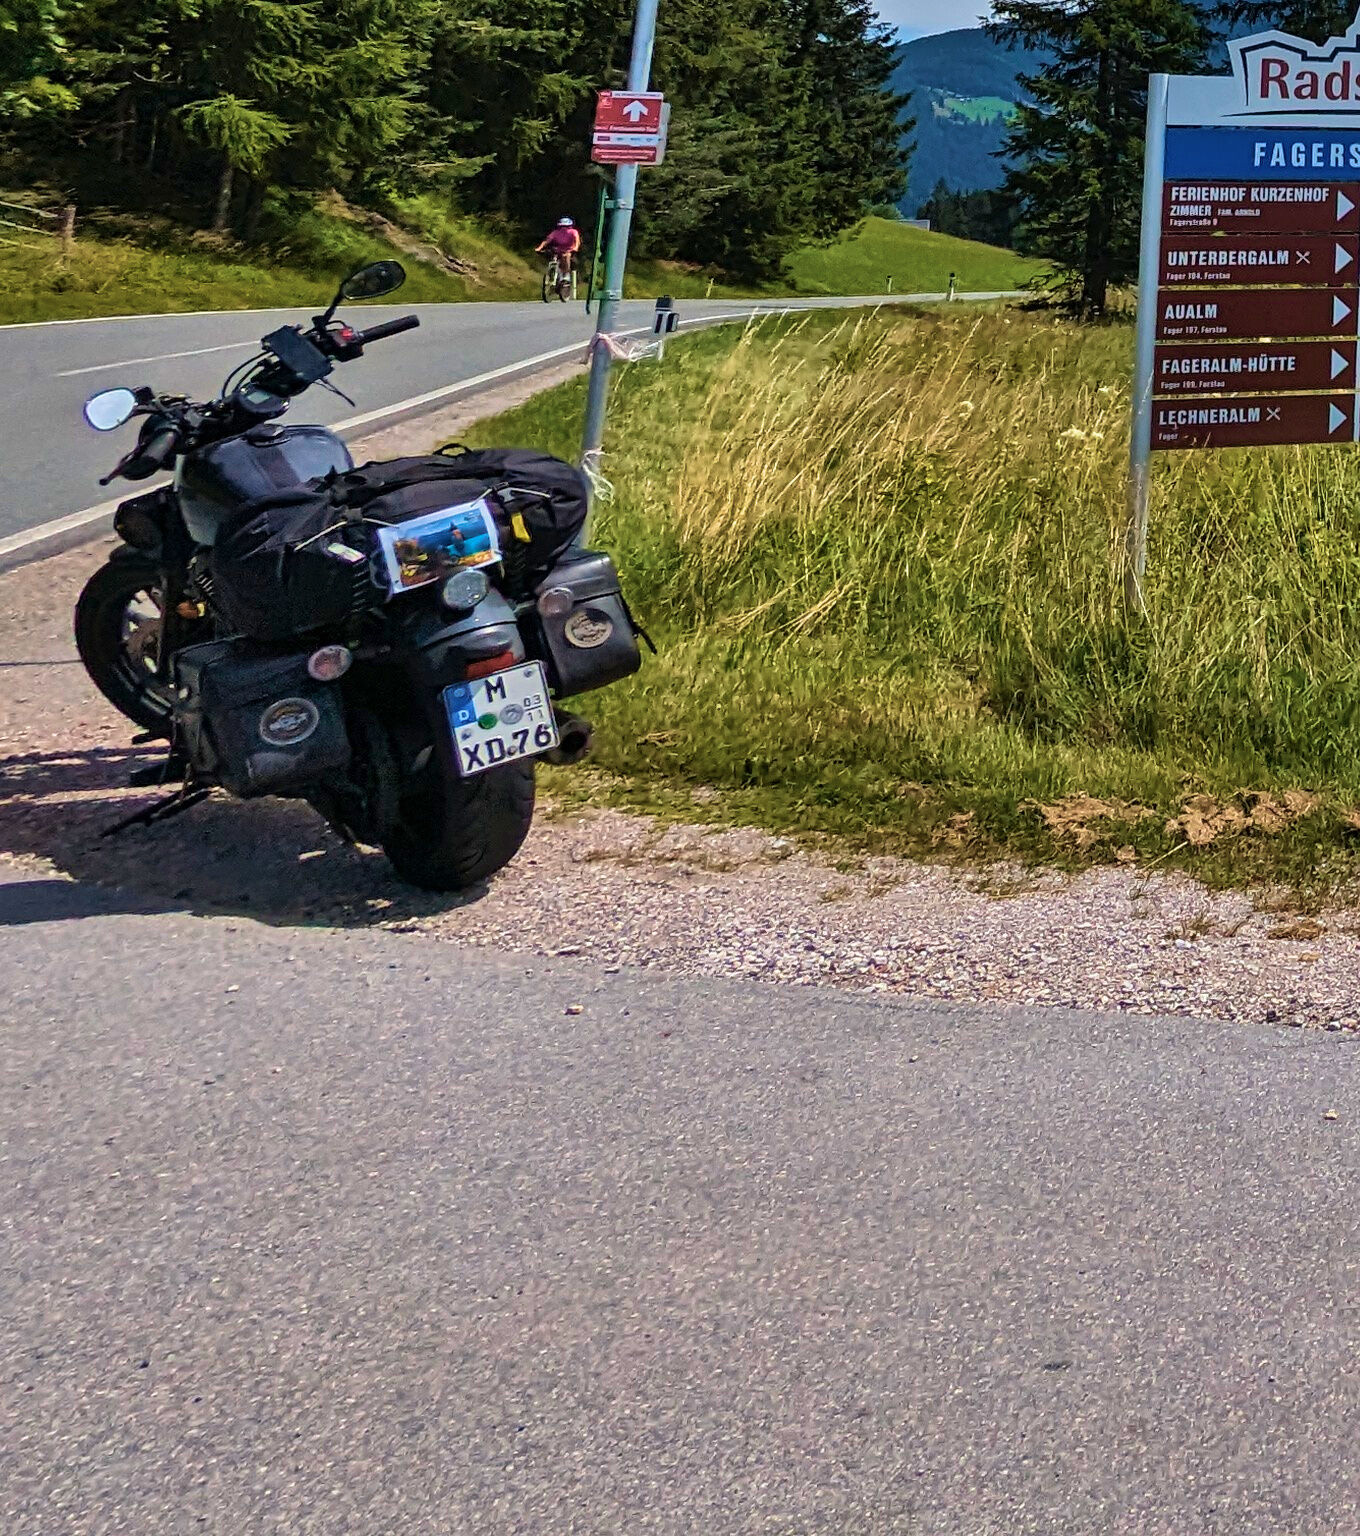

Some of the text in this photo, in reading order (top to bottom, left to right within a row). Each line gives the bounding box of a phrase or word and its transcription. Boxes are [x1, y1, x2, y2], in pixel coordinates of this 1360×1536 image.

[1171, 187, 1330, 202] FERIENHOF KURZENHOF
[1169, 205, 1212, 217] ZIMMER
[1167, 250, 1290, 266] UNTERBERGALM
[1164, 304, 1218, 320] AUALM
[1162, 353, 1296, 374] FAGERALM-HÜTTE
[1159, 407, 1261, 426] LECHNERALM
[484, 676, 506, 703] M
[458, 709, 470, 721] D
[512, 723, 552, 754] 76
